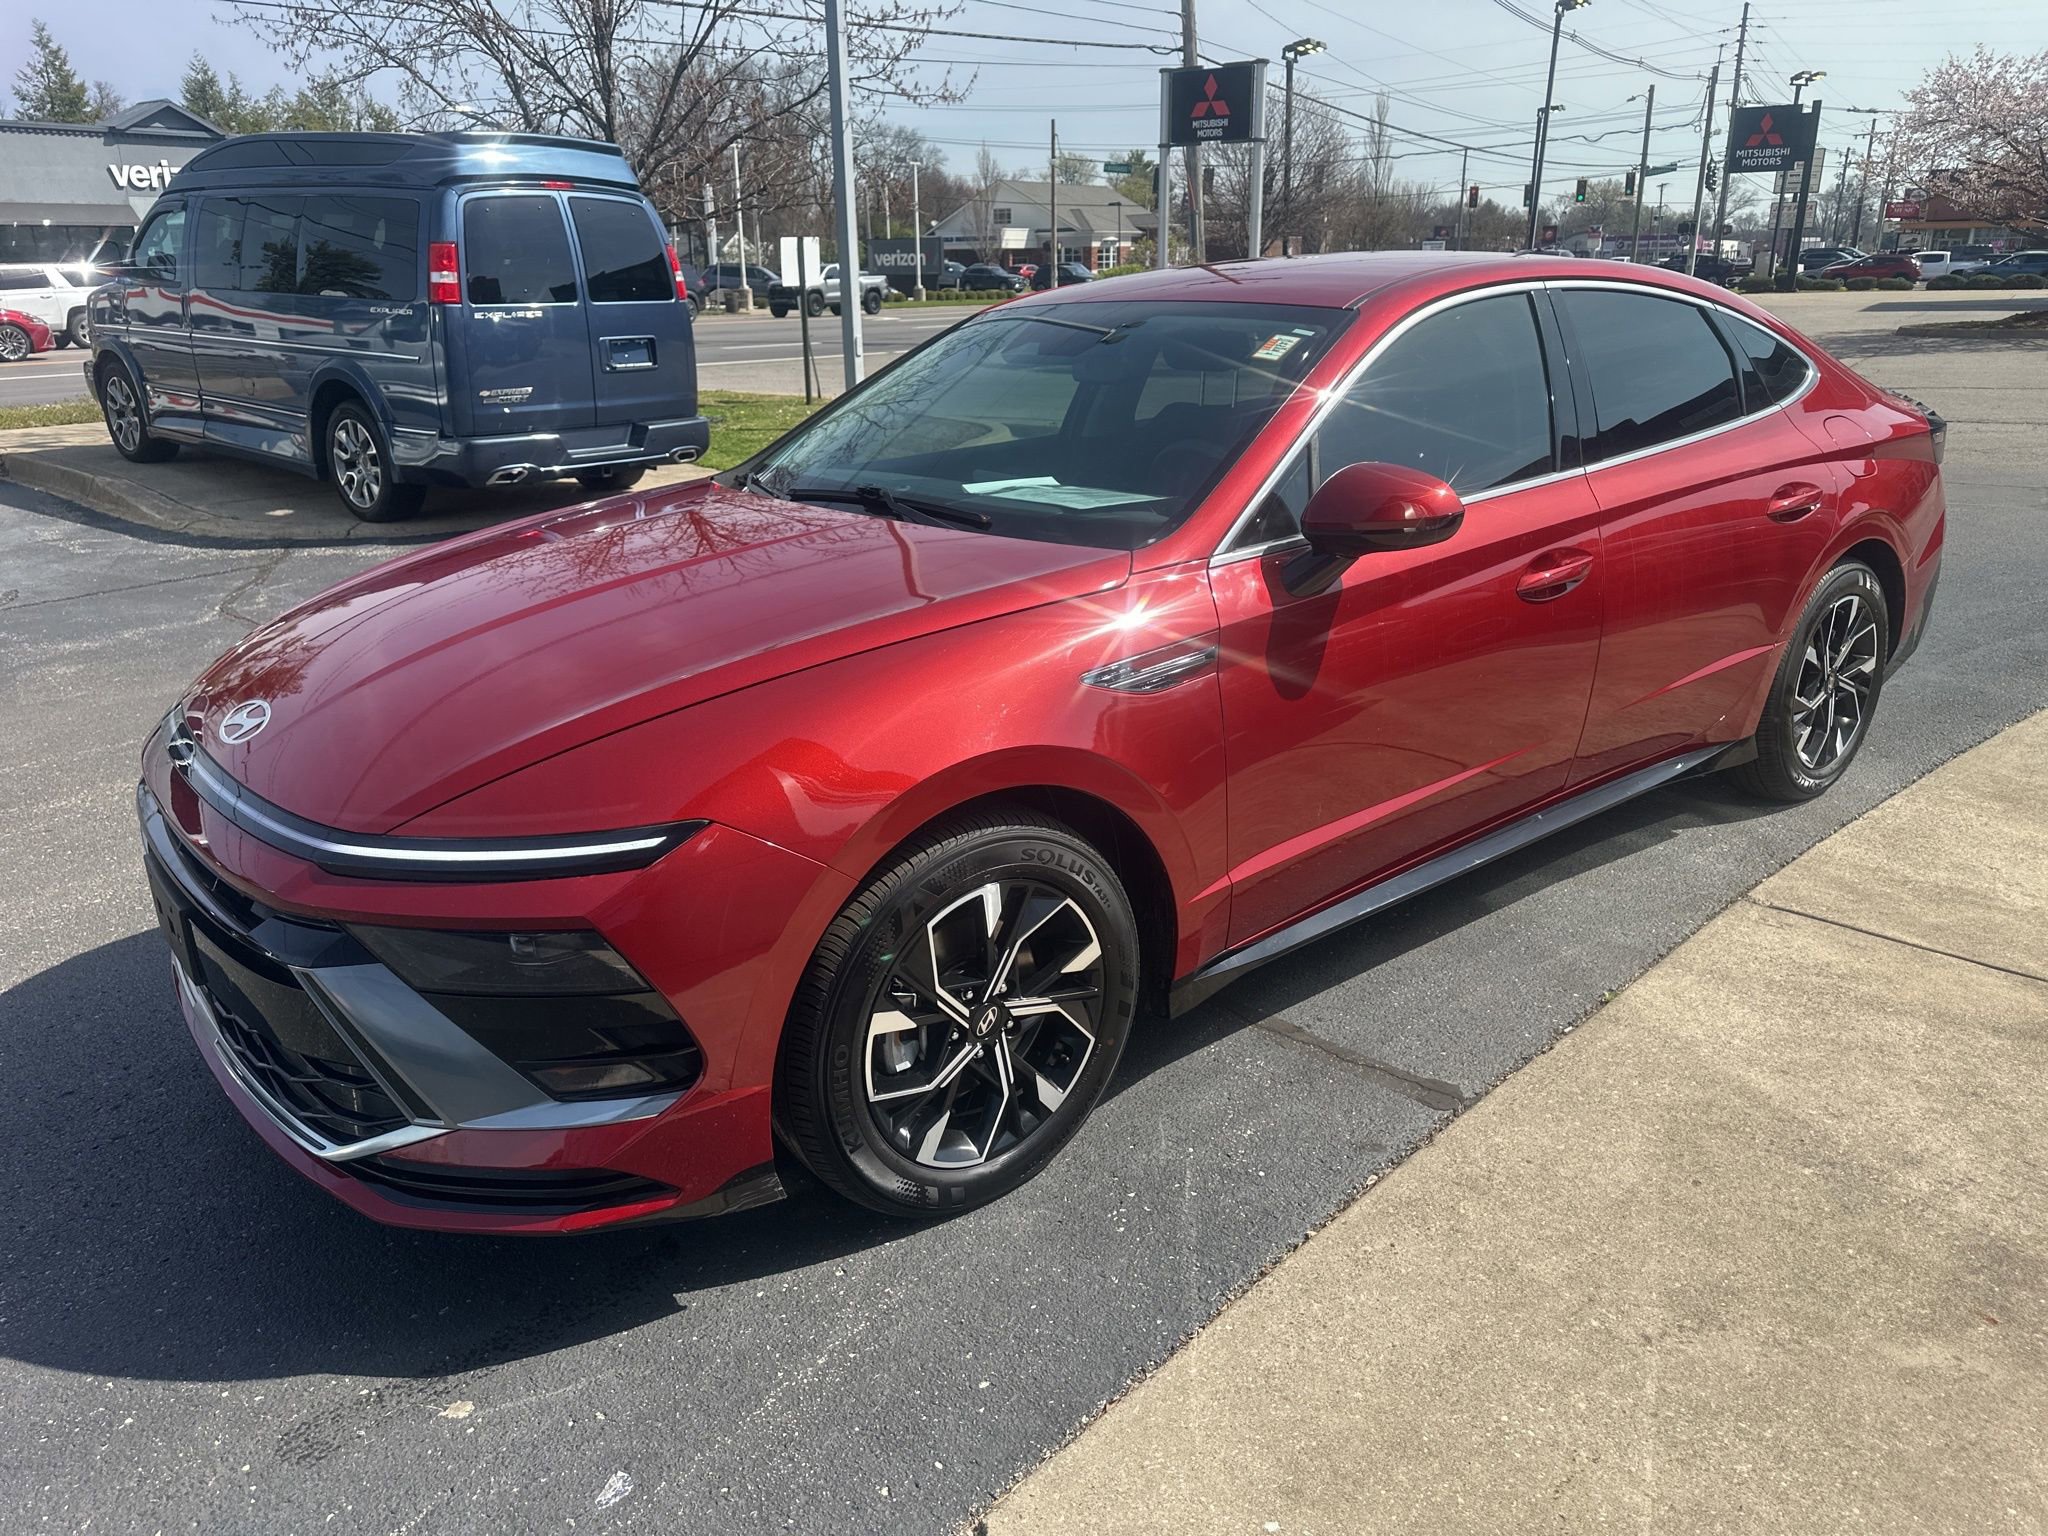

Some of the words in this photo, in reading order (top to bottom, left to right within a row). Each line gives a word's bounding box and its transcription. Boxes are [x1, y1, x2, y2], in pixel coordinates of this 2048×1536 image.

[1192, 118, 1229, 129] MITSUBISHI
[1197, 128, 1223, 138] MOTORS
[1736, 147, 1791, 158] MITSUBISHI
[1741, 157, 1782, 167] MOTORS
[107, 160, 182, 191] veri
[874, 249, 927, 267] verizon
[1021, 848, 1096, 886] SOLUS
[833, 1044, 863, 1154] KUMHO
